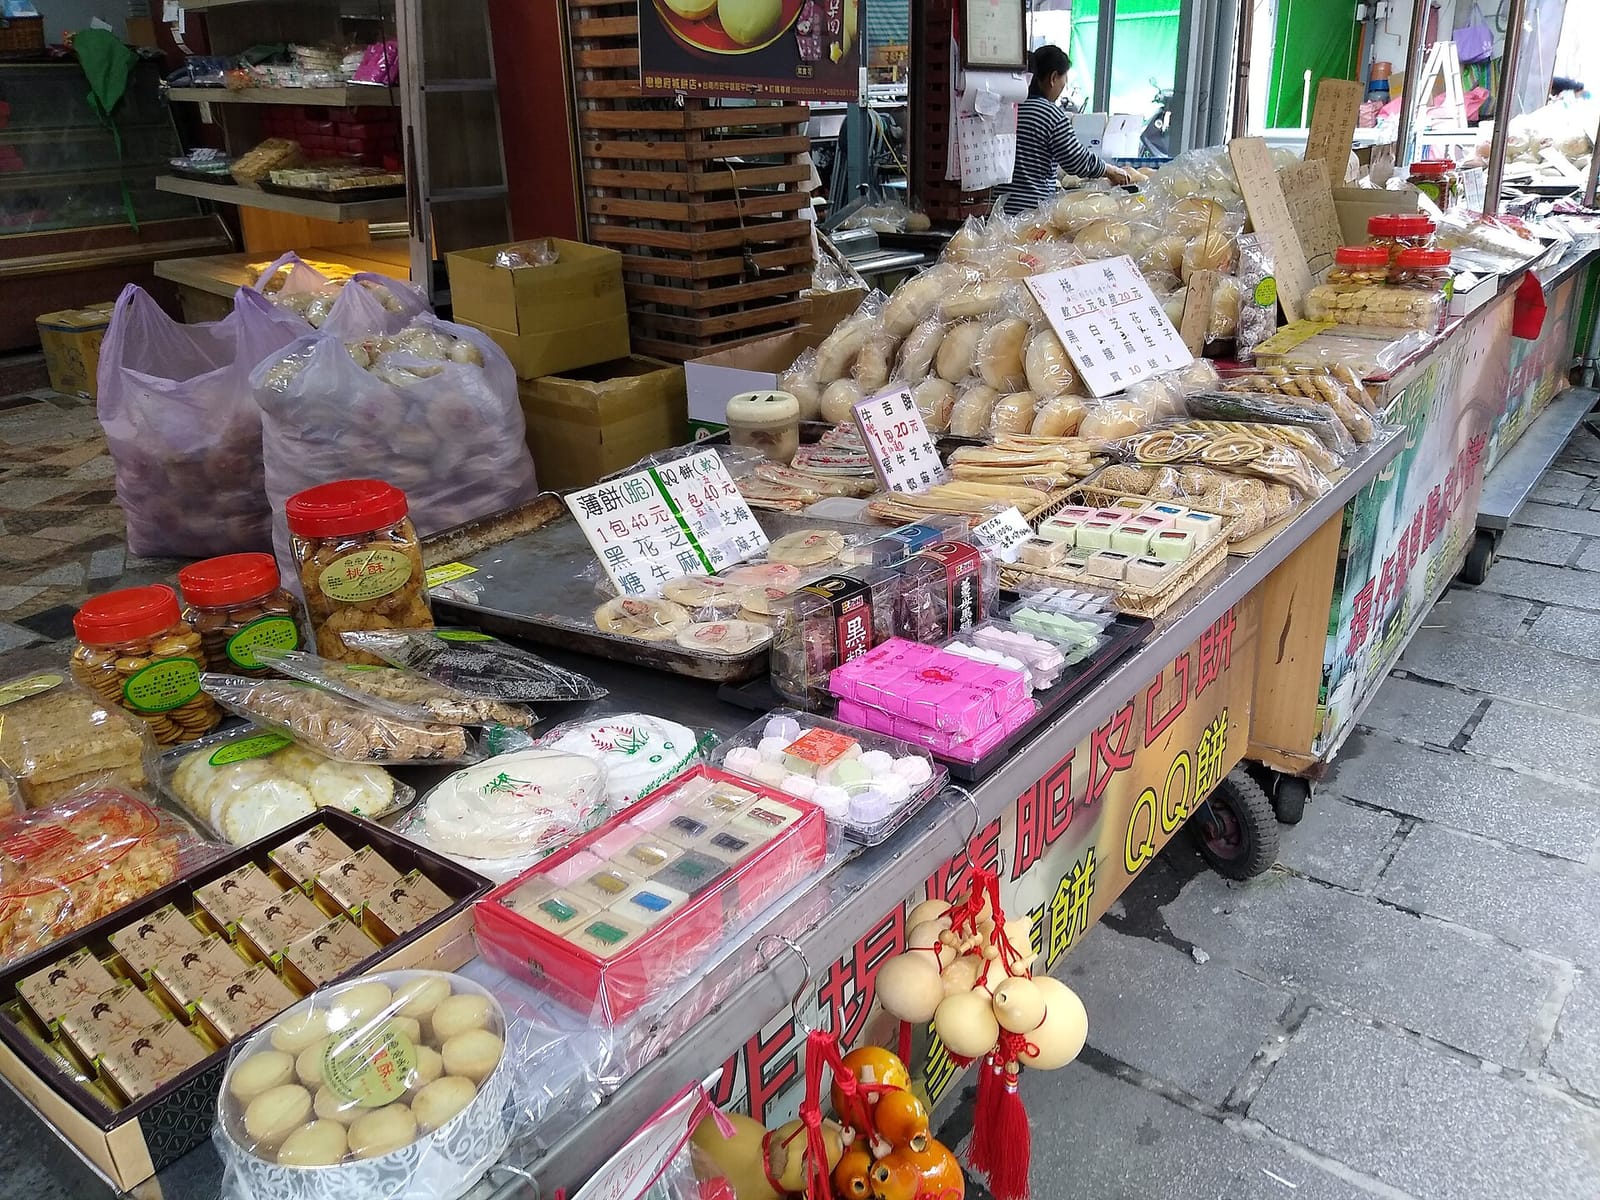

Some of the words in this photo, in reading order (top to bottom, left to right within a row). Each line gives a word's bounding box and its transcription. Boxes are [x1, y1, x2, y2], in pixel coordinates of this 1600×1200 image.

[574, 474, 657, 520] 薄餅(脆)
[672, 477, 738, 512] 1包40元
[593, 503, 671, 544] 1包40元
[344, 559, 386, 581] 桃酥
[1124, 707, 1230, 874] QQ餅
